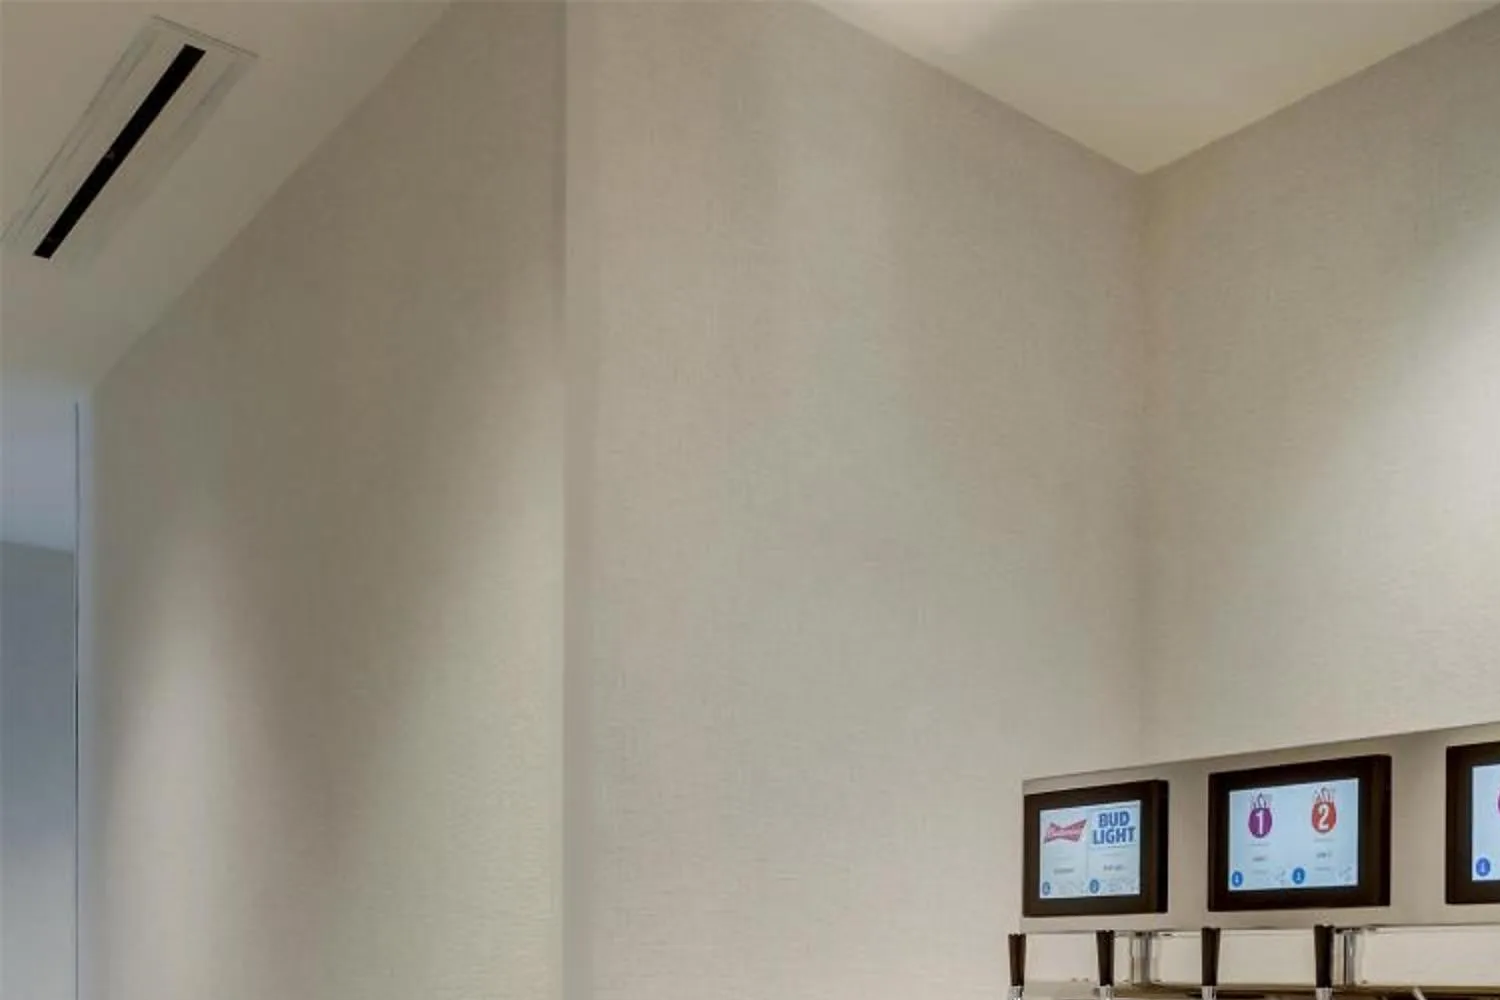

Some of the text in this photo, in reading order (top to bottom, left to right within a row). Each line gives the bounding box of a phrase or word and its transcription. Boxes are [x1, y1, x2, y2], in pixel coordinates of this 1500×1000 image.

[1098, 810, 1130, 829] BUD
[1254, 808, 1265, 835] 1
[1317, 803, 1330, 830] 2
[1092, 826, 1136, 845] LIGHT
